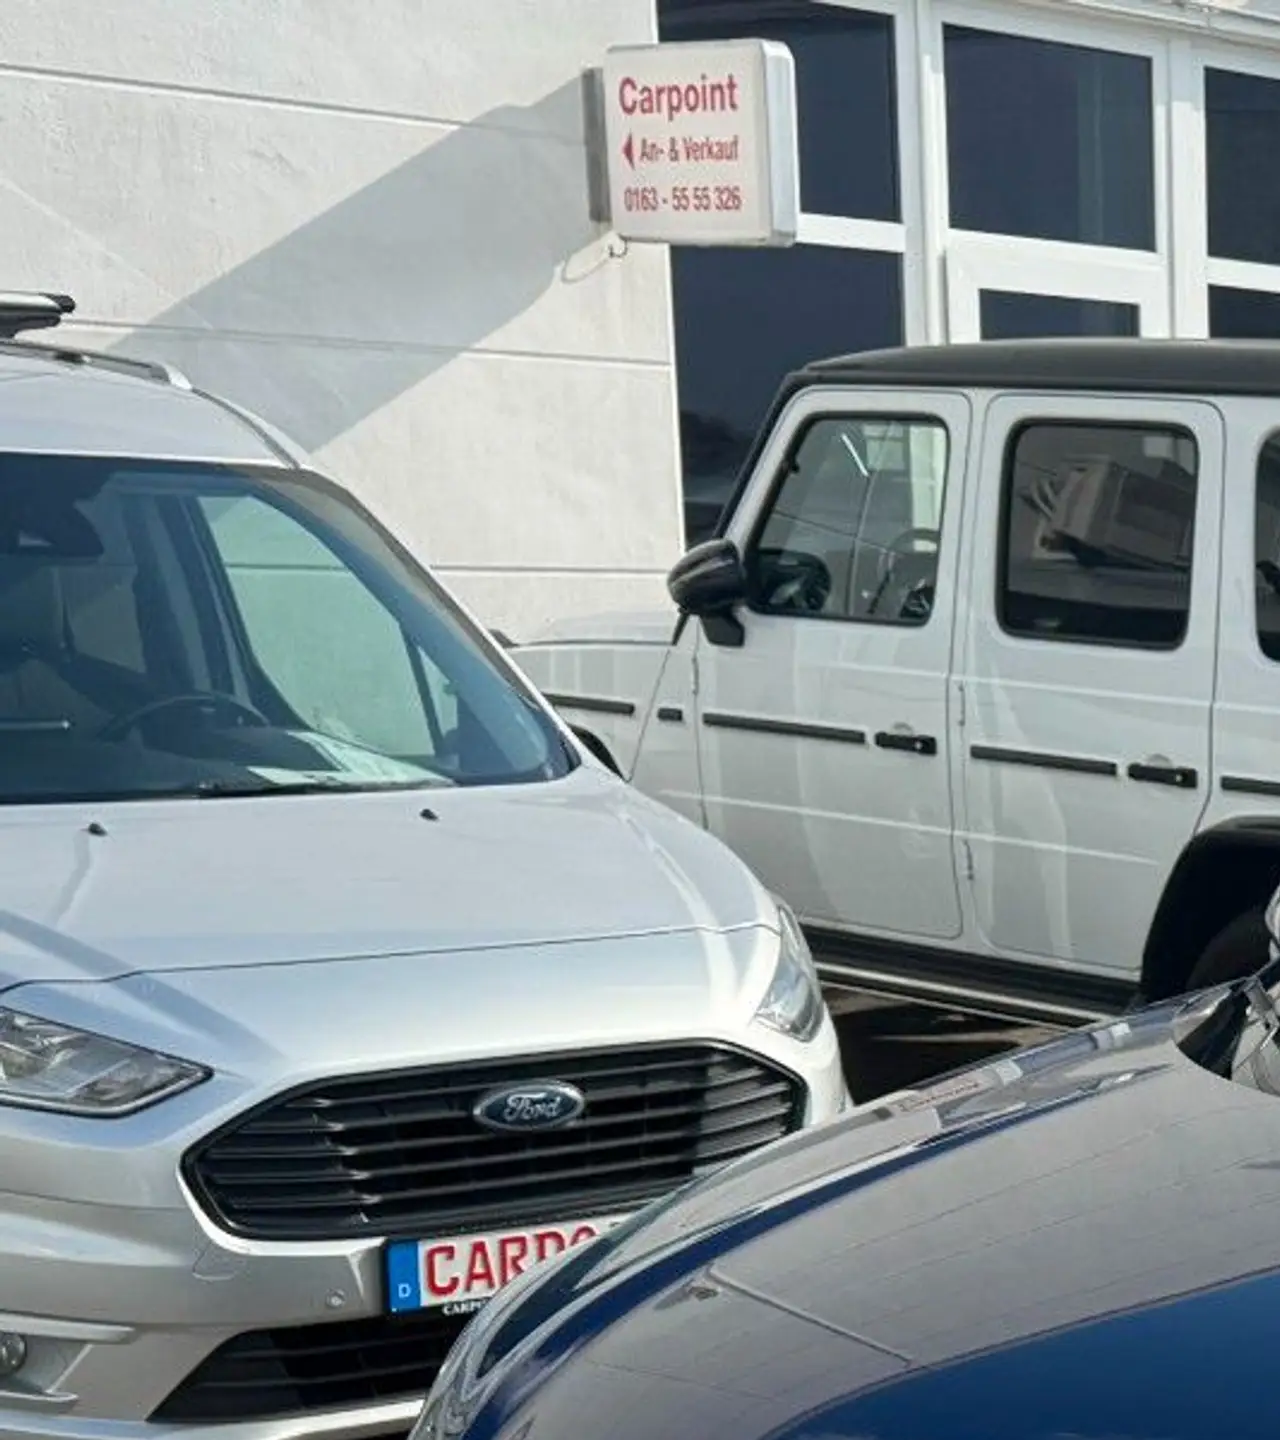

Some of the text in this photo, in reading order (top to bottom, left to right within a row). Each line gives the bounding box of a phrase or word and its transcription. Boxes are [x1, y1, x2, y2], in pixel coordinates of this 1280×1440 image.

[618, 72, 739, 122] Carpoint
[667, 136, 680, 162] &
[683, 134, 739, 161] Verkauf
[623, 186, 660, 212] 0163
[671, 186, 690, 212] 55
[692, 186, 712, 212] 55
[713, 185, 742, 211] 326
[504, 1092, 561, 1121] Ford
[399, 1283, 412, 1298] D
